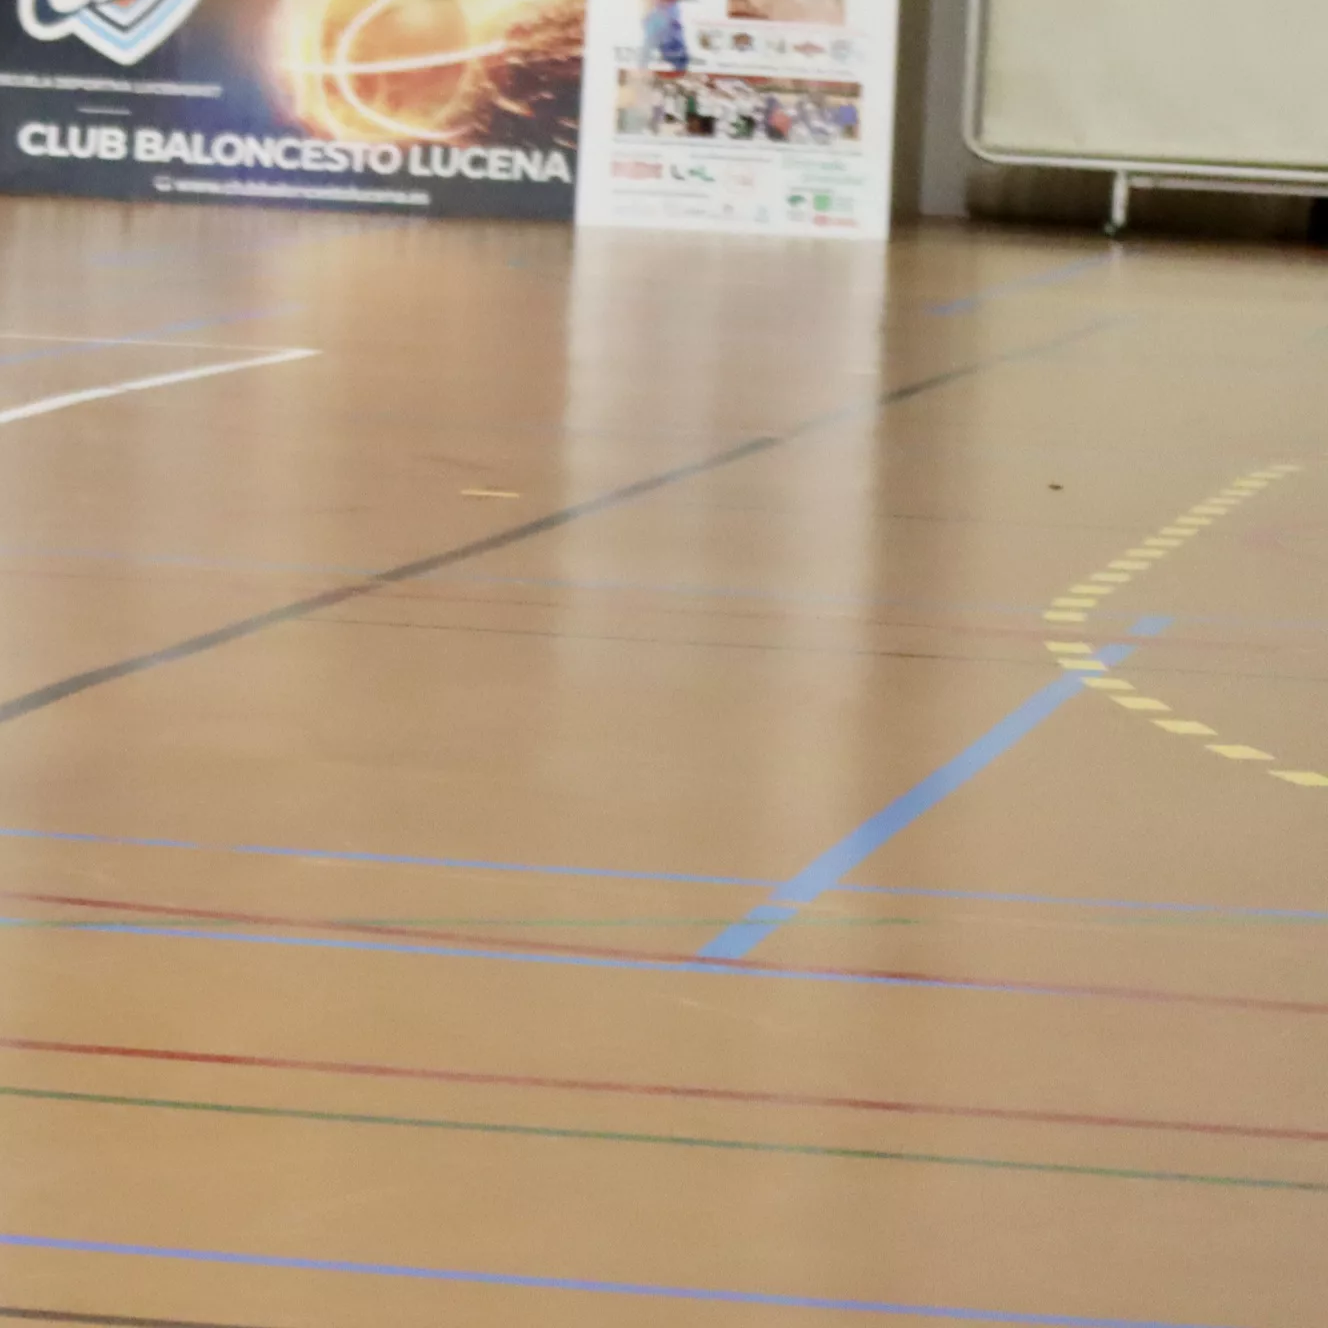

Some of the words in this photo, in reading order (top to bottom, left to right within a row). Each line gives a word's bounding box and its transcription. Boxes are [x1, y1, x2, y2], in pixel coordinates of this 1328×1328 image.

[17, 123, 127, 160] CLUB
[133, 130, 402, 174] BALONCESTO
[407, 144, 572, 184] LUCENA
